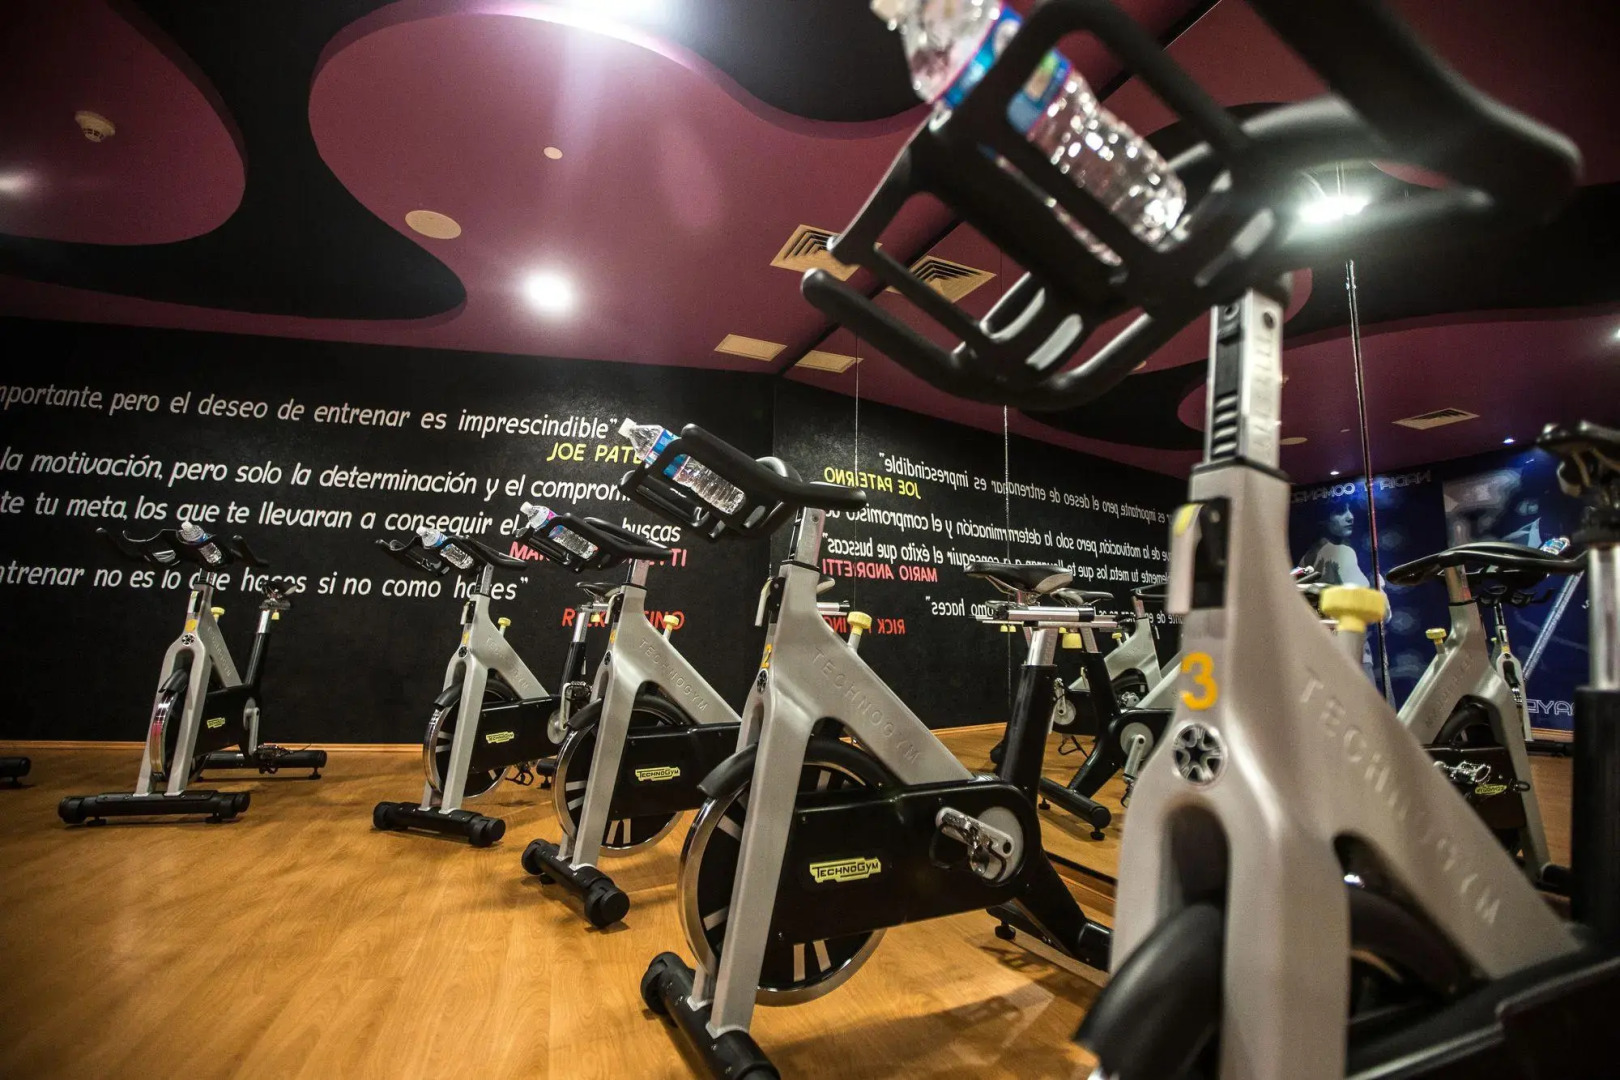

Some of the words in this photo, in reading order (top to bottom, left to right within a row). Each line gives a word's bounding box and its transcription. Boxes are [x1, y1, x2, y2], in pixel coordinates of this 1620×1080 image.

[109, 391, 160, 416] pero
[170, 391, 191, 413] el
[198, 394, 268, 419] deseo
[277, 399, 305, 423] de
[313, 402, 410, 428] entrenar
[421, 411, 447, 430] es
[546, 442, 587, 462] JOE
[0, 446, 23, 471] la
[168, 461, 228, 487] pero
[235, 460, 282, 485] solo
[291, 462, 312, 486] la
[319, 464, 477, 495] determinación
[484, 477, 499, 501] y
[505, 475, 526, 496] el
[35, 492, 58, 515] tu
[135, 495, 168, 520] los
[176, 502, 219, 525] que
[226, 501, 250, 523] te
[258, 502, 351, 529] llevaran
[360, 510, 376, 530] a
[384, 511, 493, 535] conseguir
[500, 514, 520, 535] el
[93, 569, 122, 587] no
[129, 570, 155, 588] es
[161, 569, 181, 589] lo
[317, 571, 338, 594] si
[343, 575, 371, 595] no
[382, 578, 441, 598] como
[760, 643, 772, 669] 2
[1180, 652, 1219, 711] 3
